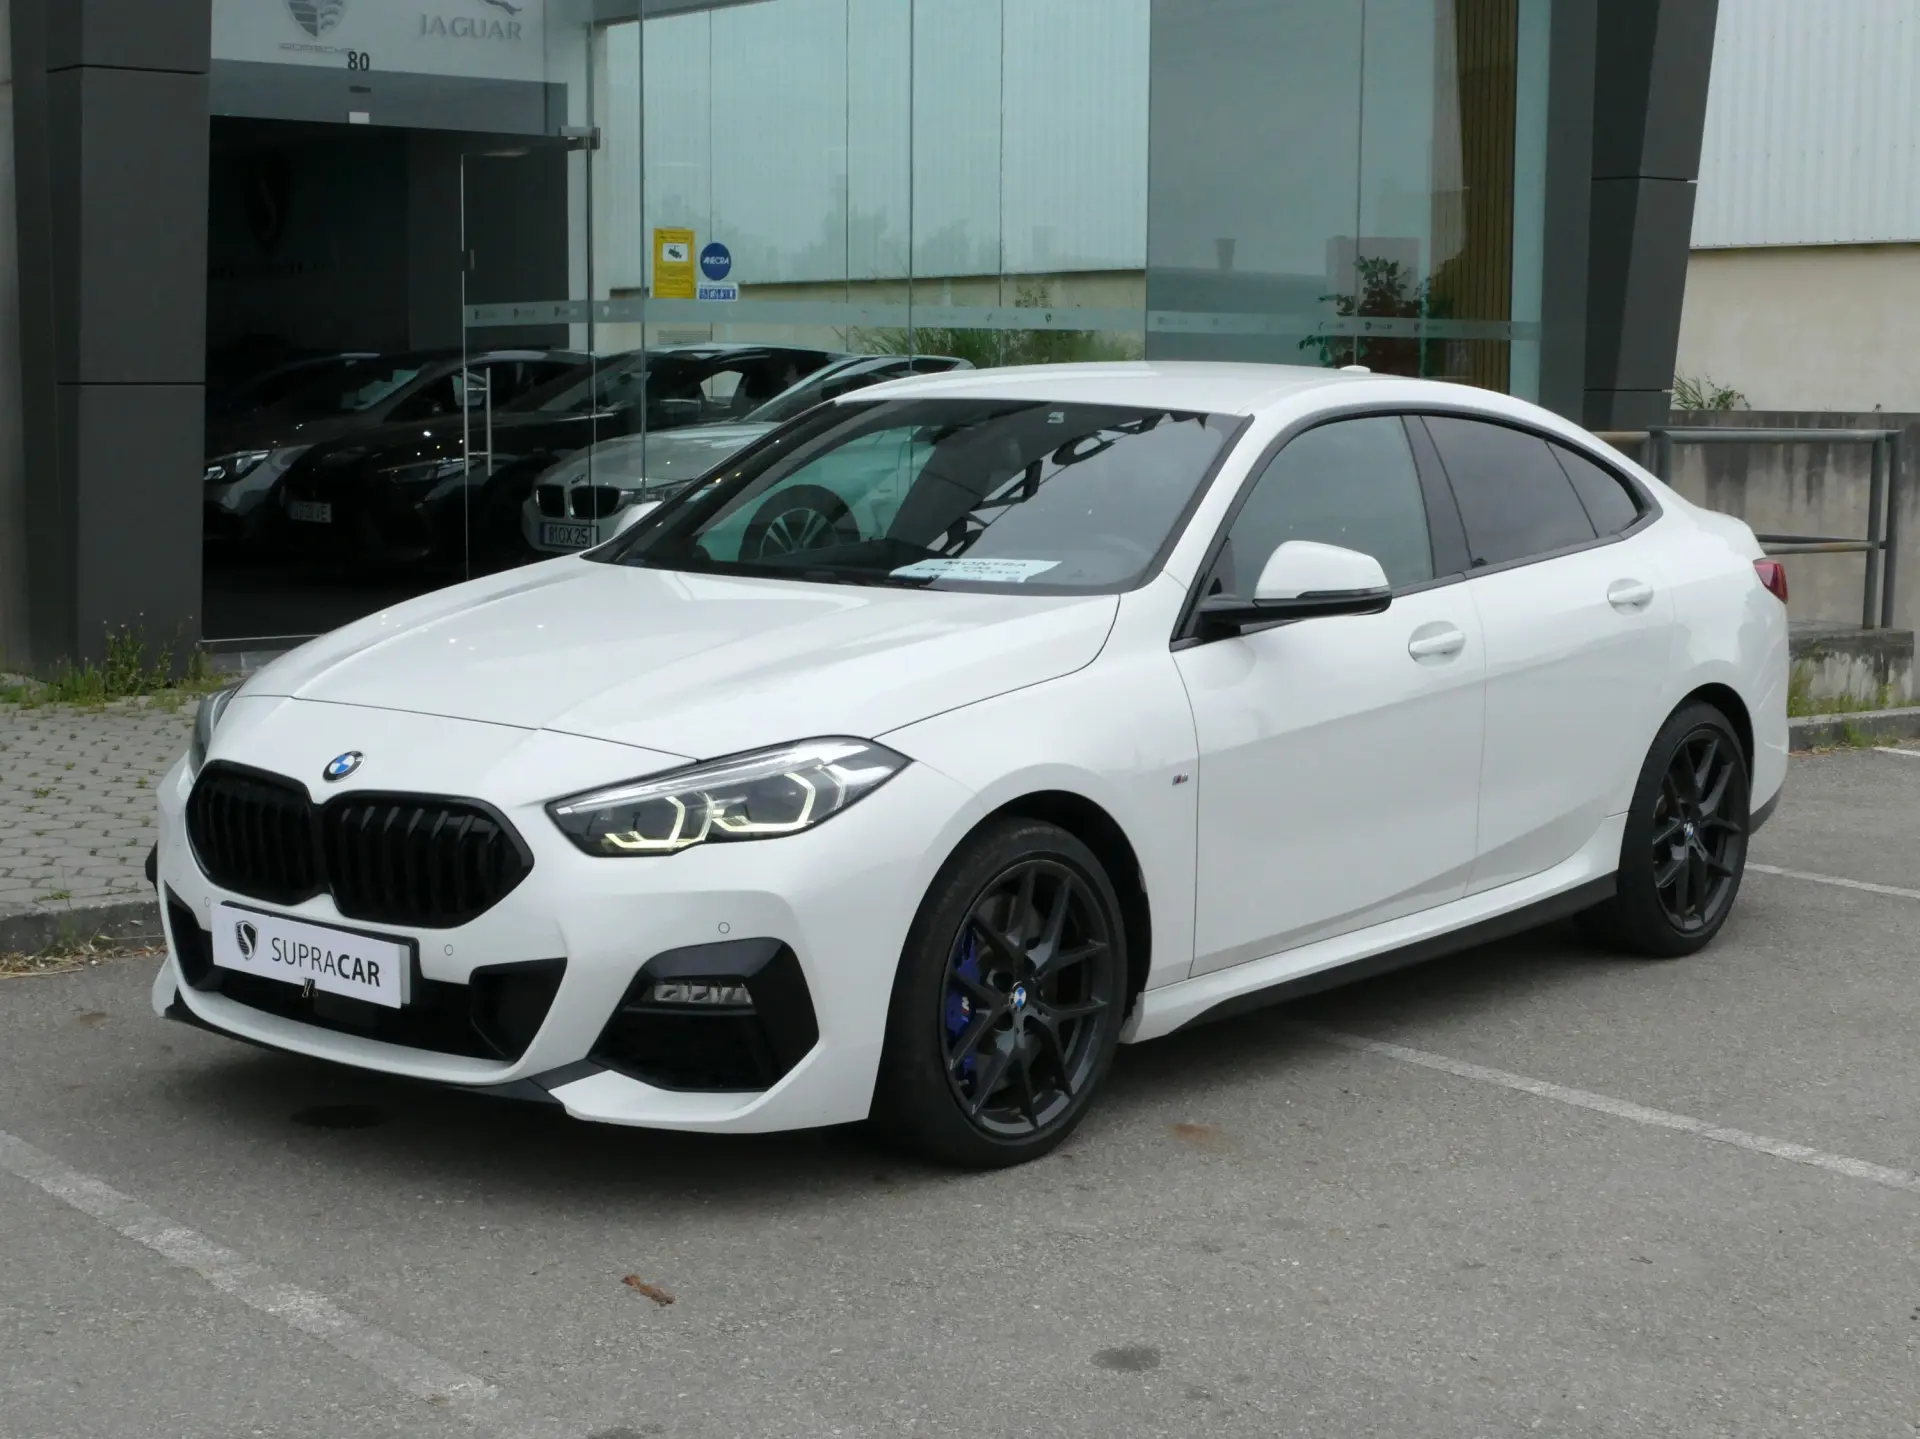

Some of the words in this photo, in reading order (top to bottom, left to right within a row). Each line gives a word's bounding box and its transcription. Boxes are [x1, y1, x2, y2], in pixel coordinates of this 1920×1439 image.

[419, 13, 522, 41] JAGUAR
[347, 51, 370, 71] 80
[271, 937, 381, 987] SUPRACAR
